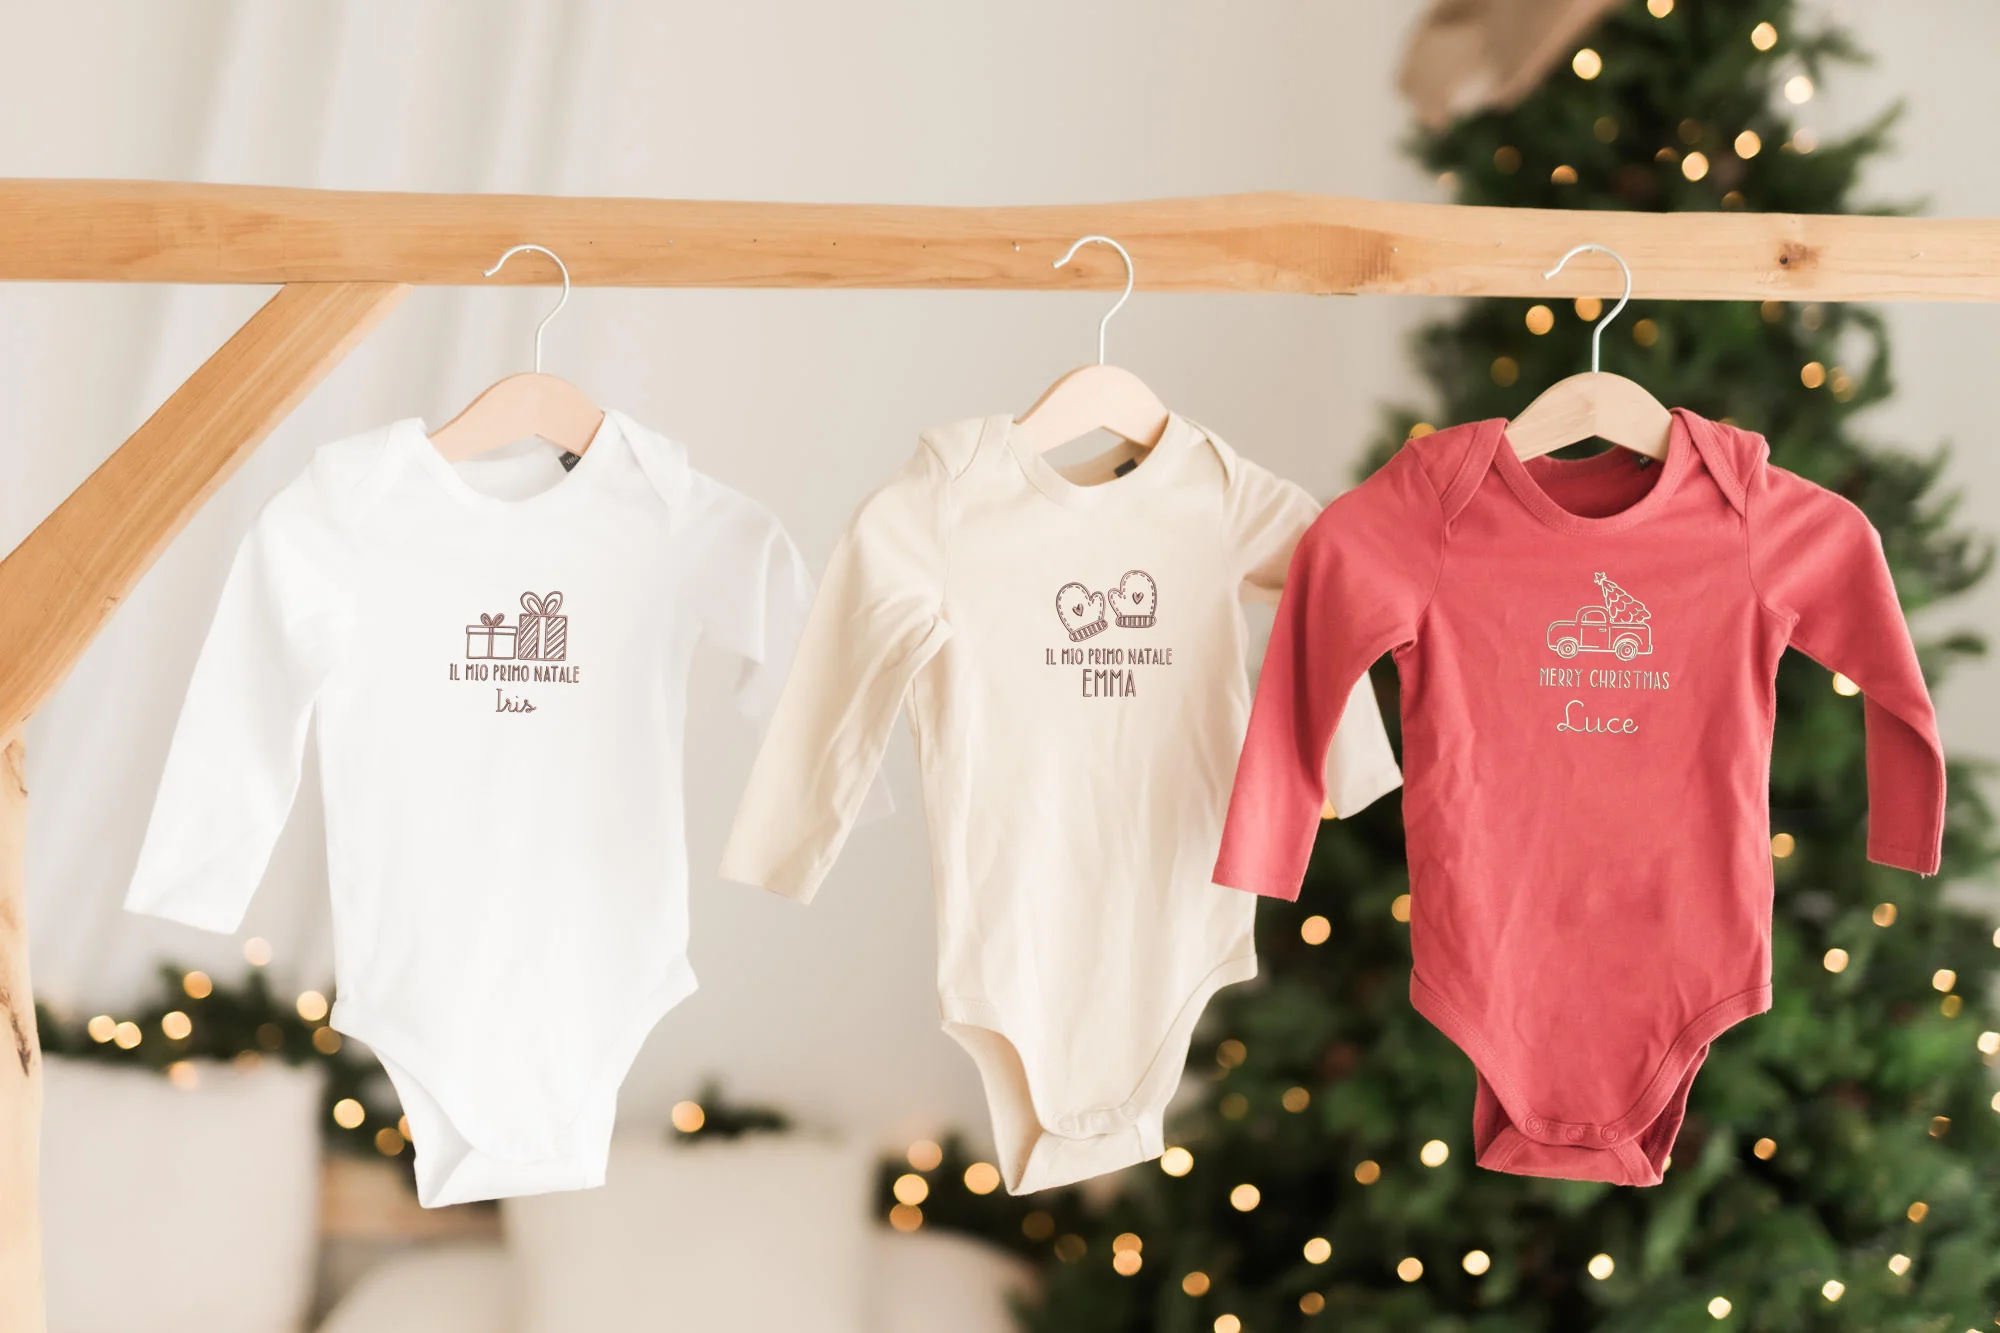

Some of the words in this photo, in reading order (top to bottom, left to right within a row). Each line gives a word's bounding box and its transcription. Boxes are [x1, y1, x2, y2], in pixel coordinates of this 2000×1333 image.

[1045, 648, 1057, 666] IL
[1061, 648, 1084, 666] MIO
[1088, 648, 1125, 666] PRIMO
[1128, 648, 1173, 666] NATALE
[449, 663, 461, 681] IL
[465, 664, 489, 682] MIO
[492, 664, 530, 683] PRIMO
[533, 665, 580, 684] NATALE
[1082, 668, 1137, 698] EMMA
[1539, 667, 1583, 688] MERRY
[1589, 669, 1670, 690] CHRISTMAS
[495, 688, 537, 714] Iris
[1556, 699, 1639, 734] Luce
